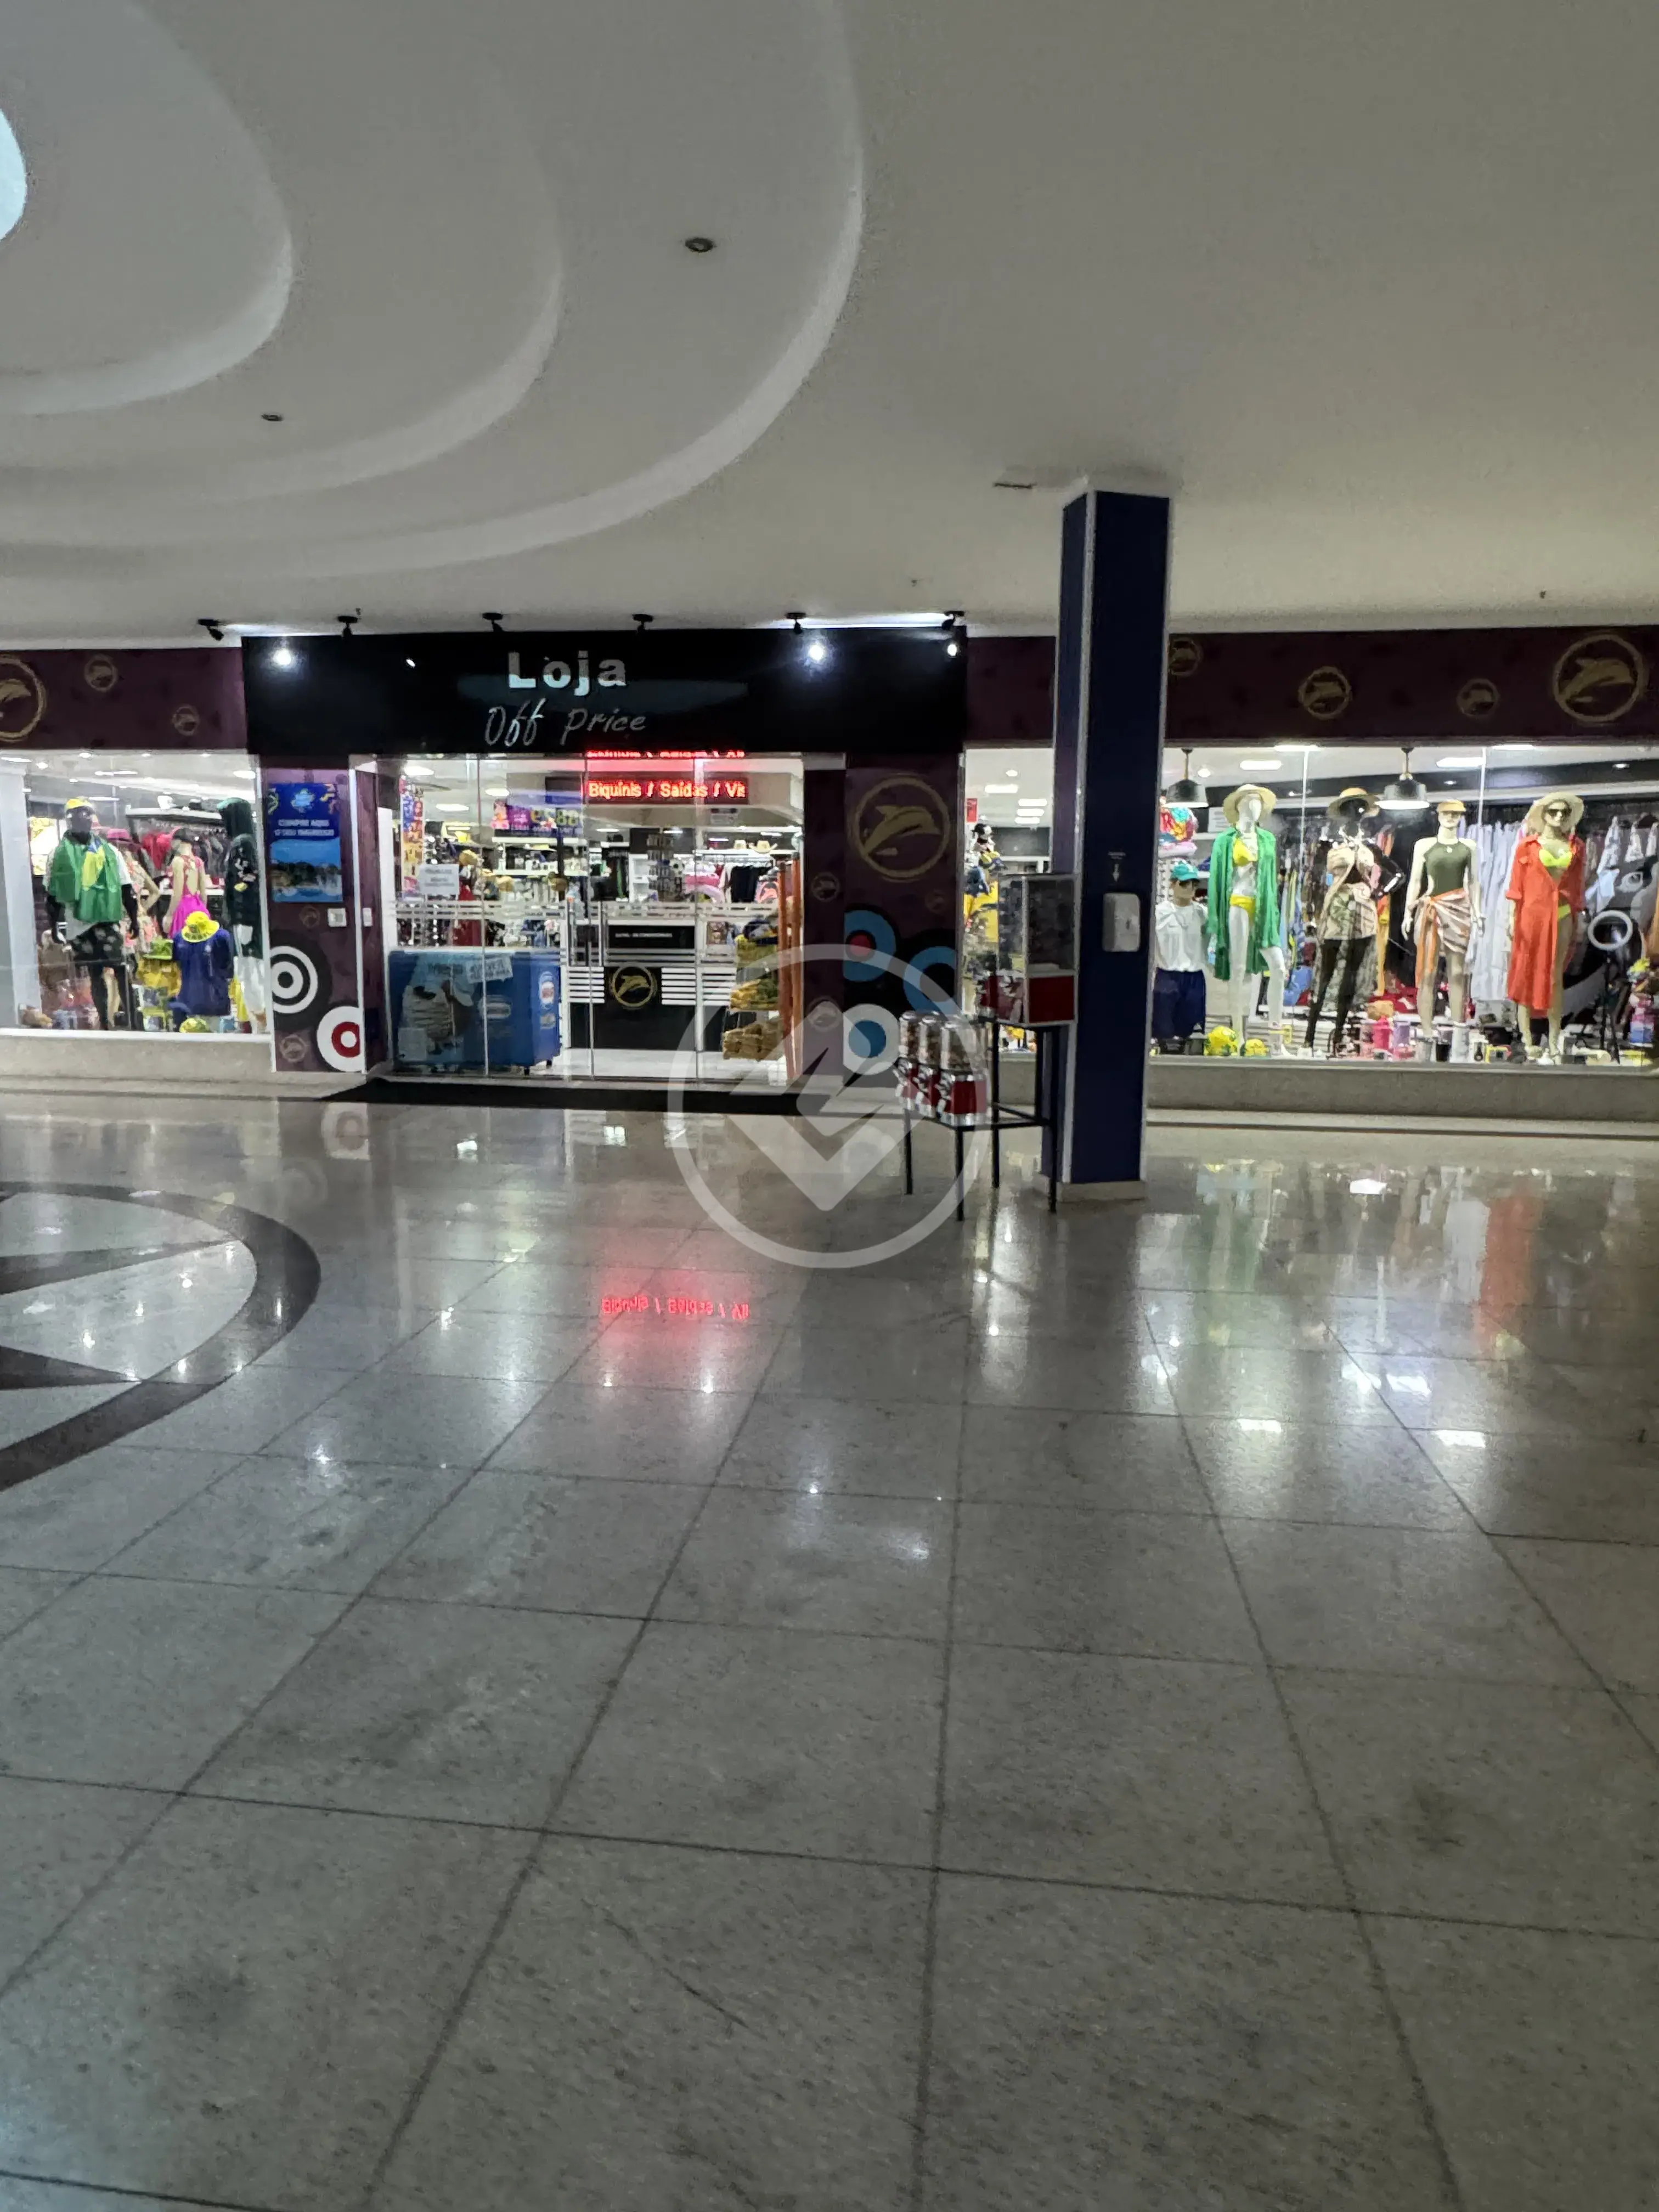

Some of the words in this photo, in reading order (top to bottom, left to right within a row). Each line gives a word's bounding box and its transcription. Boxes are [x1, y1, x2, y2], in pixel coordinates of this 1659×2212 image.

[507, 650, 627, 697] Loja
[484, 698, 547, 747] Off
[560, 707, 647, 746] Price
